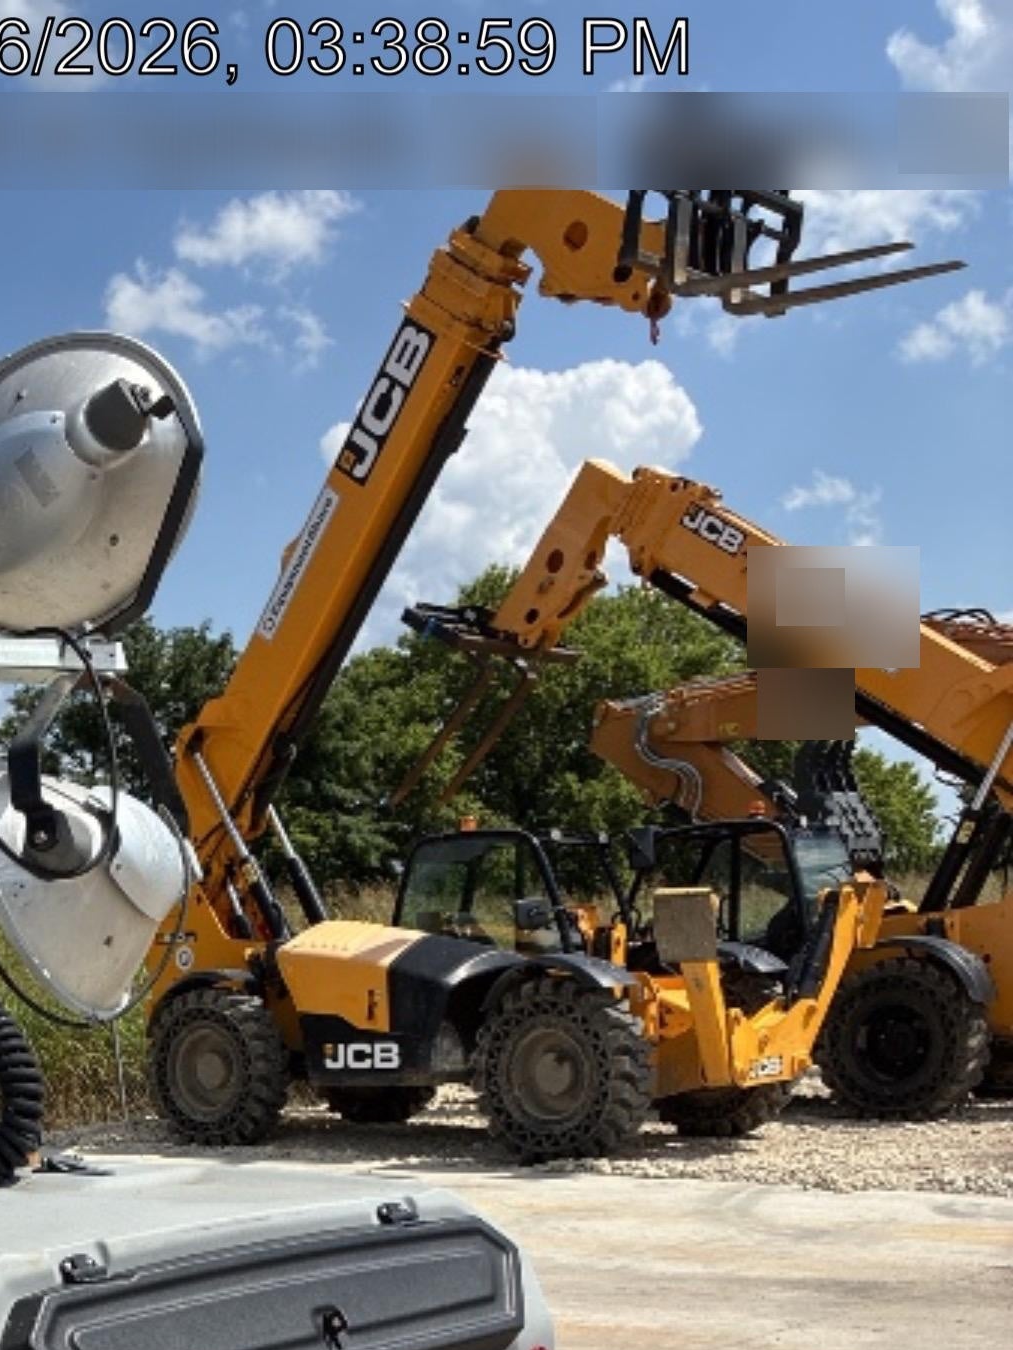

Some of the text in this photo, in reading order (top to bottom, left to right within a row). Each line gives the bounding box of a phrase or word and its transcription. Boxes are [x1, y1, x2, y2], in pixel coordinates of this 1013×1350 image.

[351, 324, 431, 479] JCB
[683, 508, 745, 553] JCB
[324, 1042, 400, 1069] JCB
